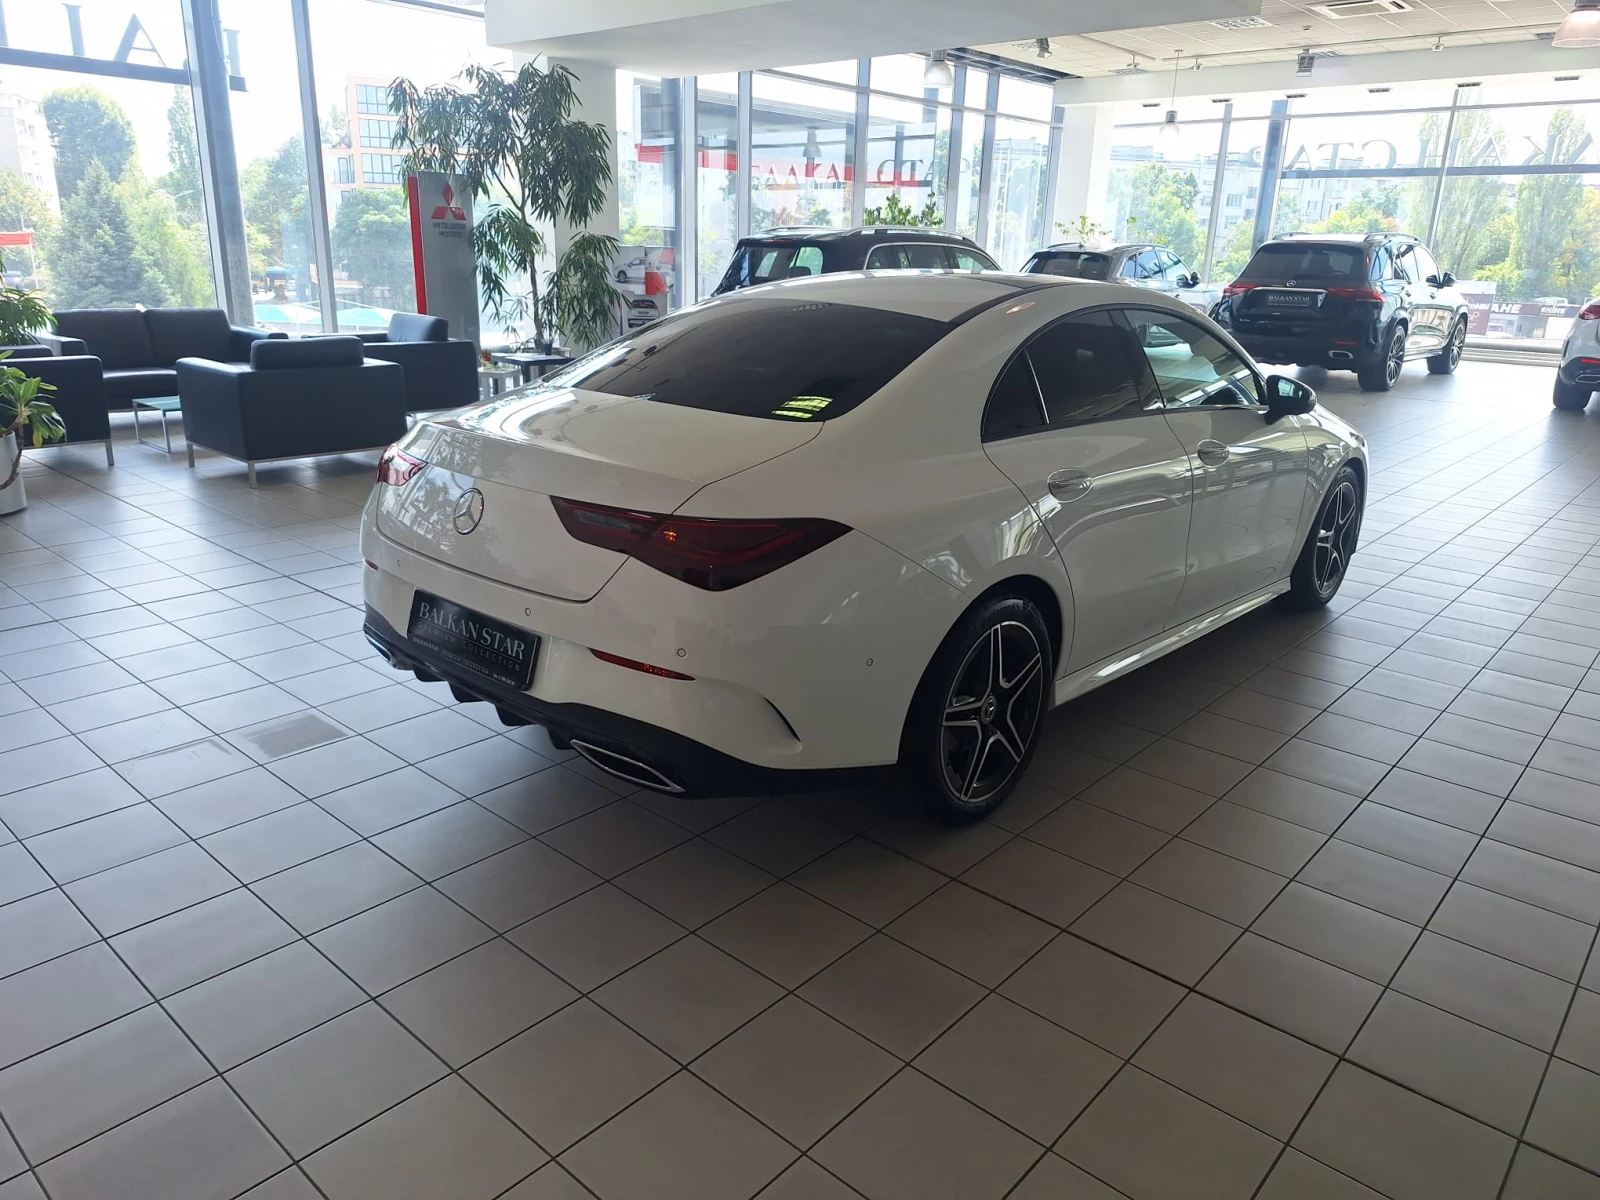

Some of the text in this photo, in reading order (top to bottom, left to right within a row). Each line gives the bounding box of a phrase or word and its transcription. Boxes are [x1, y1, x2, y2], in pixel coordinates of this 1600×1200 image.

[418, 621, 520, 672] PREMIUM COLLECTION
[420, 602, 525, 660] BALKAN STAR
